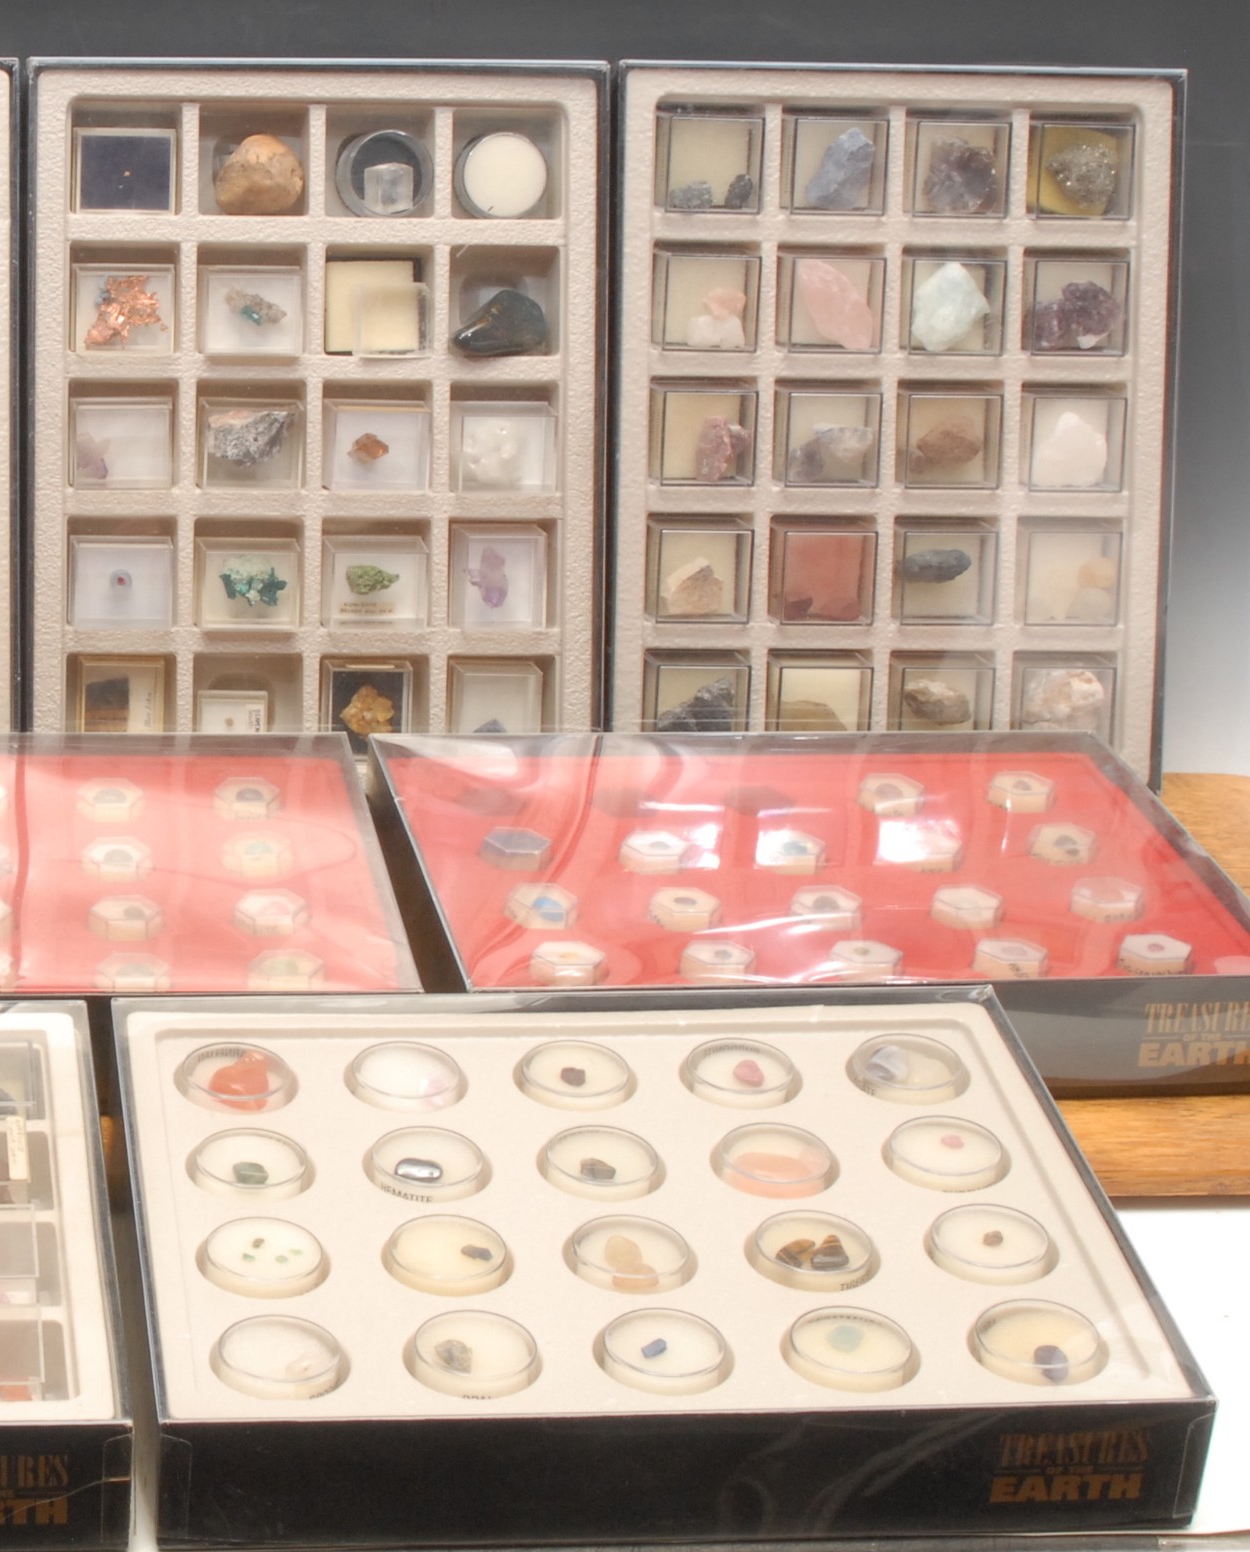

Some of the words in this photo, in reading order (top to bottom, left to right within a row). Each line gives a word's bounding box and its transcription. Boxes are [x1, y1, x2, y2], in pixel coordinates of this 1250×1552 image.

[1145, 1001, 1250, 1033] TREASURE
[1137, 1041, 1250, 1067] EARTH
[380, 1181, 433, 1203] HEMATITE
[1000, 1430, 1149, 1467] TREASURES
[989, 1473, 1144, 1504] EARTH
